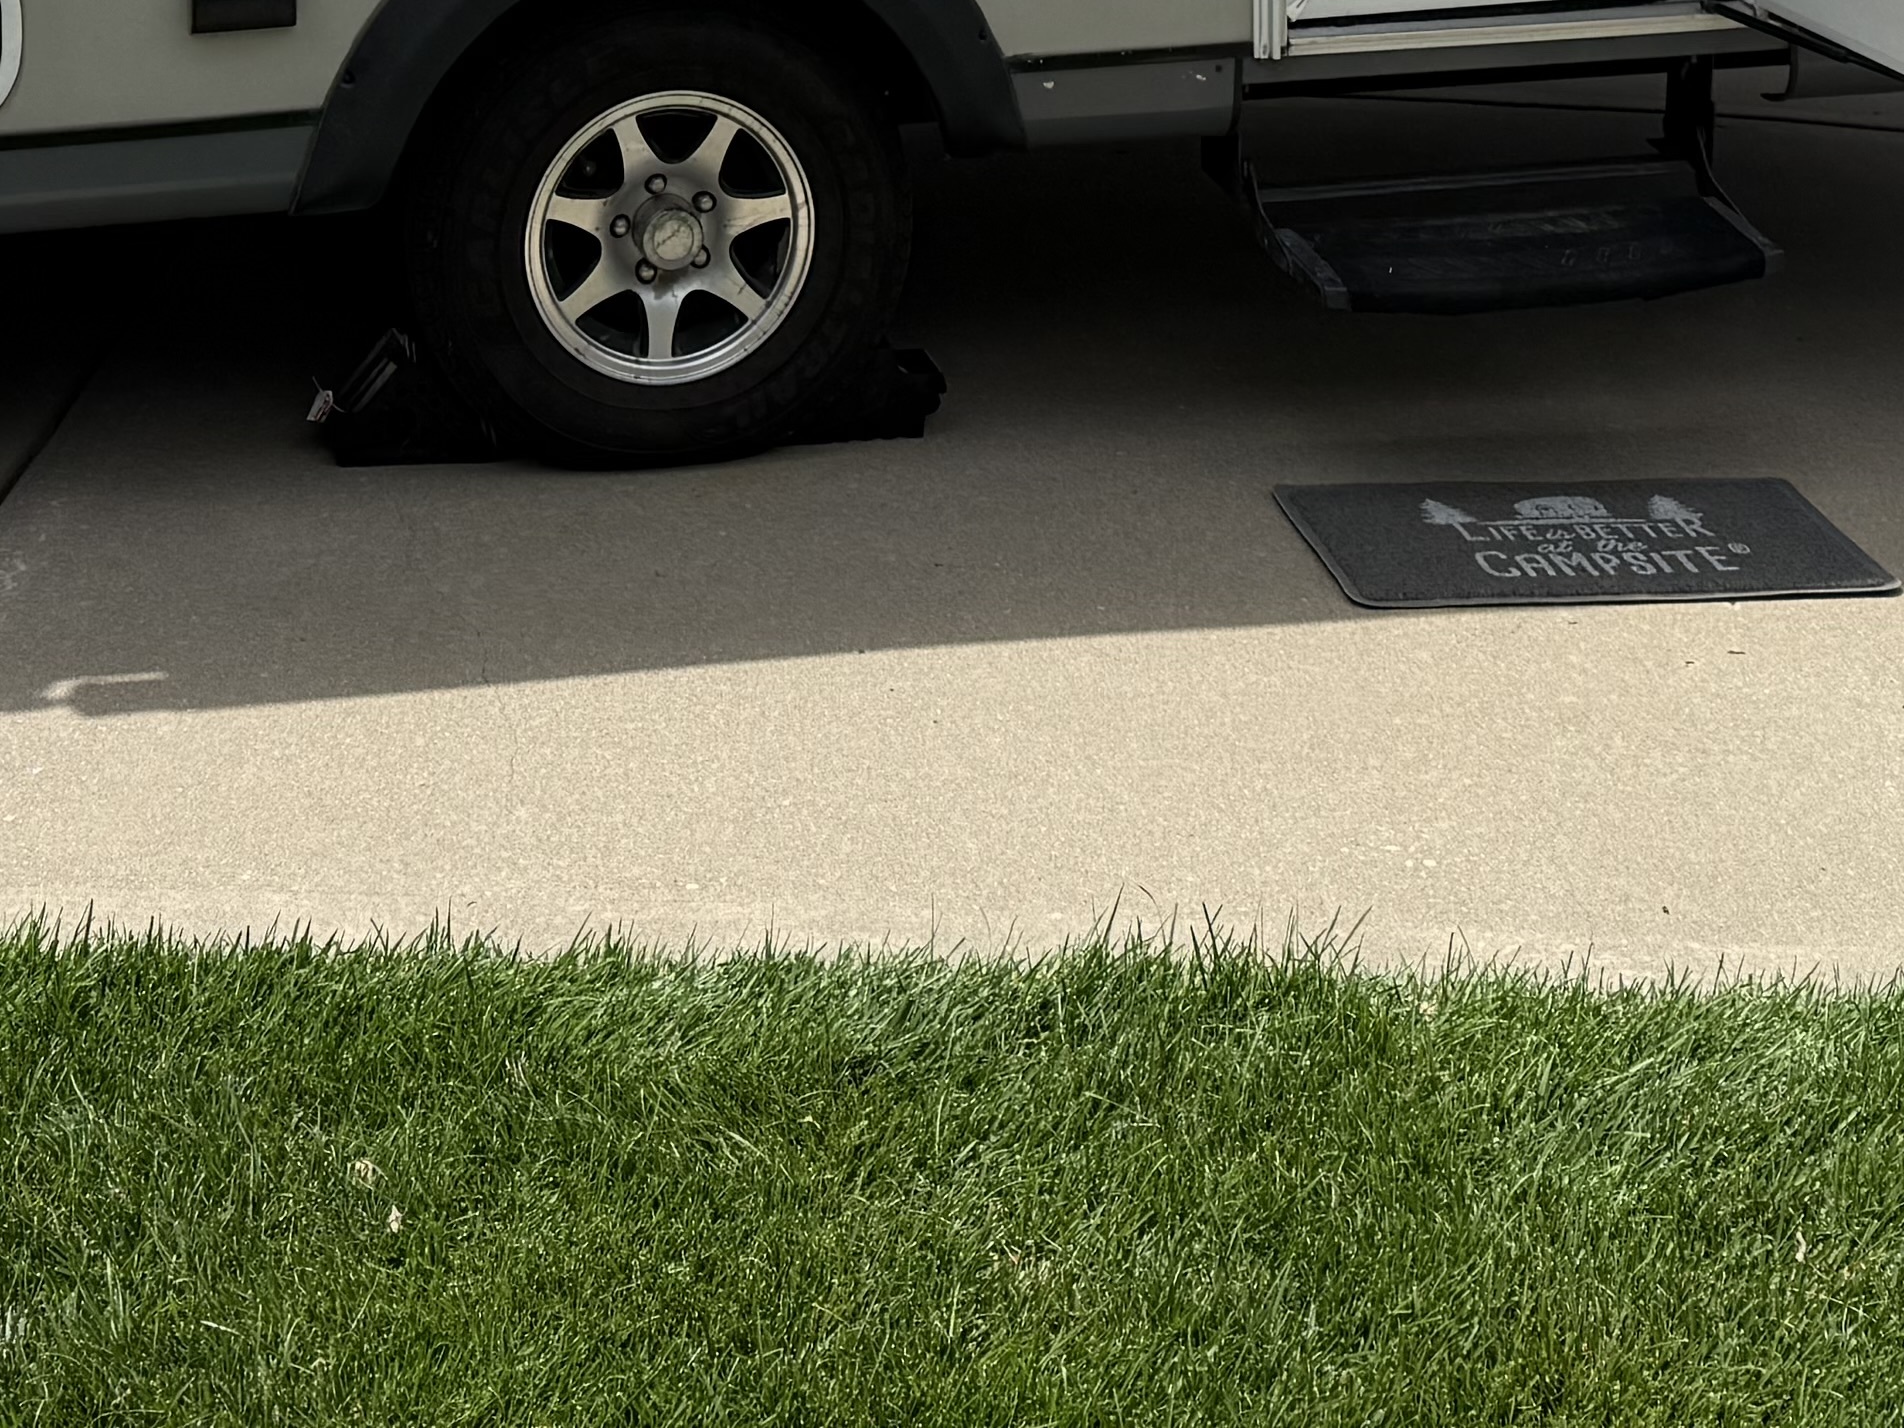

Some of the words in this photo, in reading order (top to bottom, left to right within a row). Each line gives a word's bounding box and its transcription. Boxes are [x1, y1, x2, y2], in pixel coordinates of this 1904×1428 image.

[1454, 522, 1543, 541] LIFE
[1576, 516, 1715, 540] BETTER
[1538, 541, 1573, 553] at
[1597, 540, 1648, 553] the
